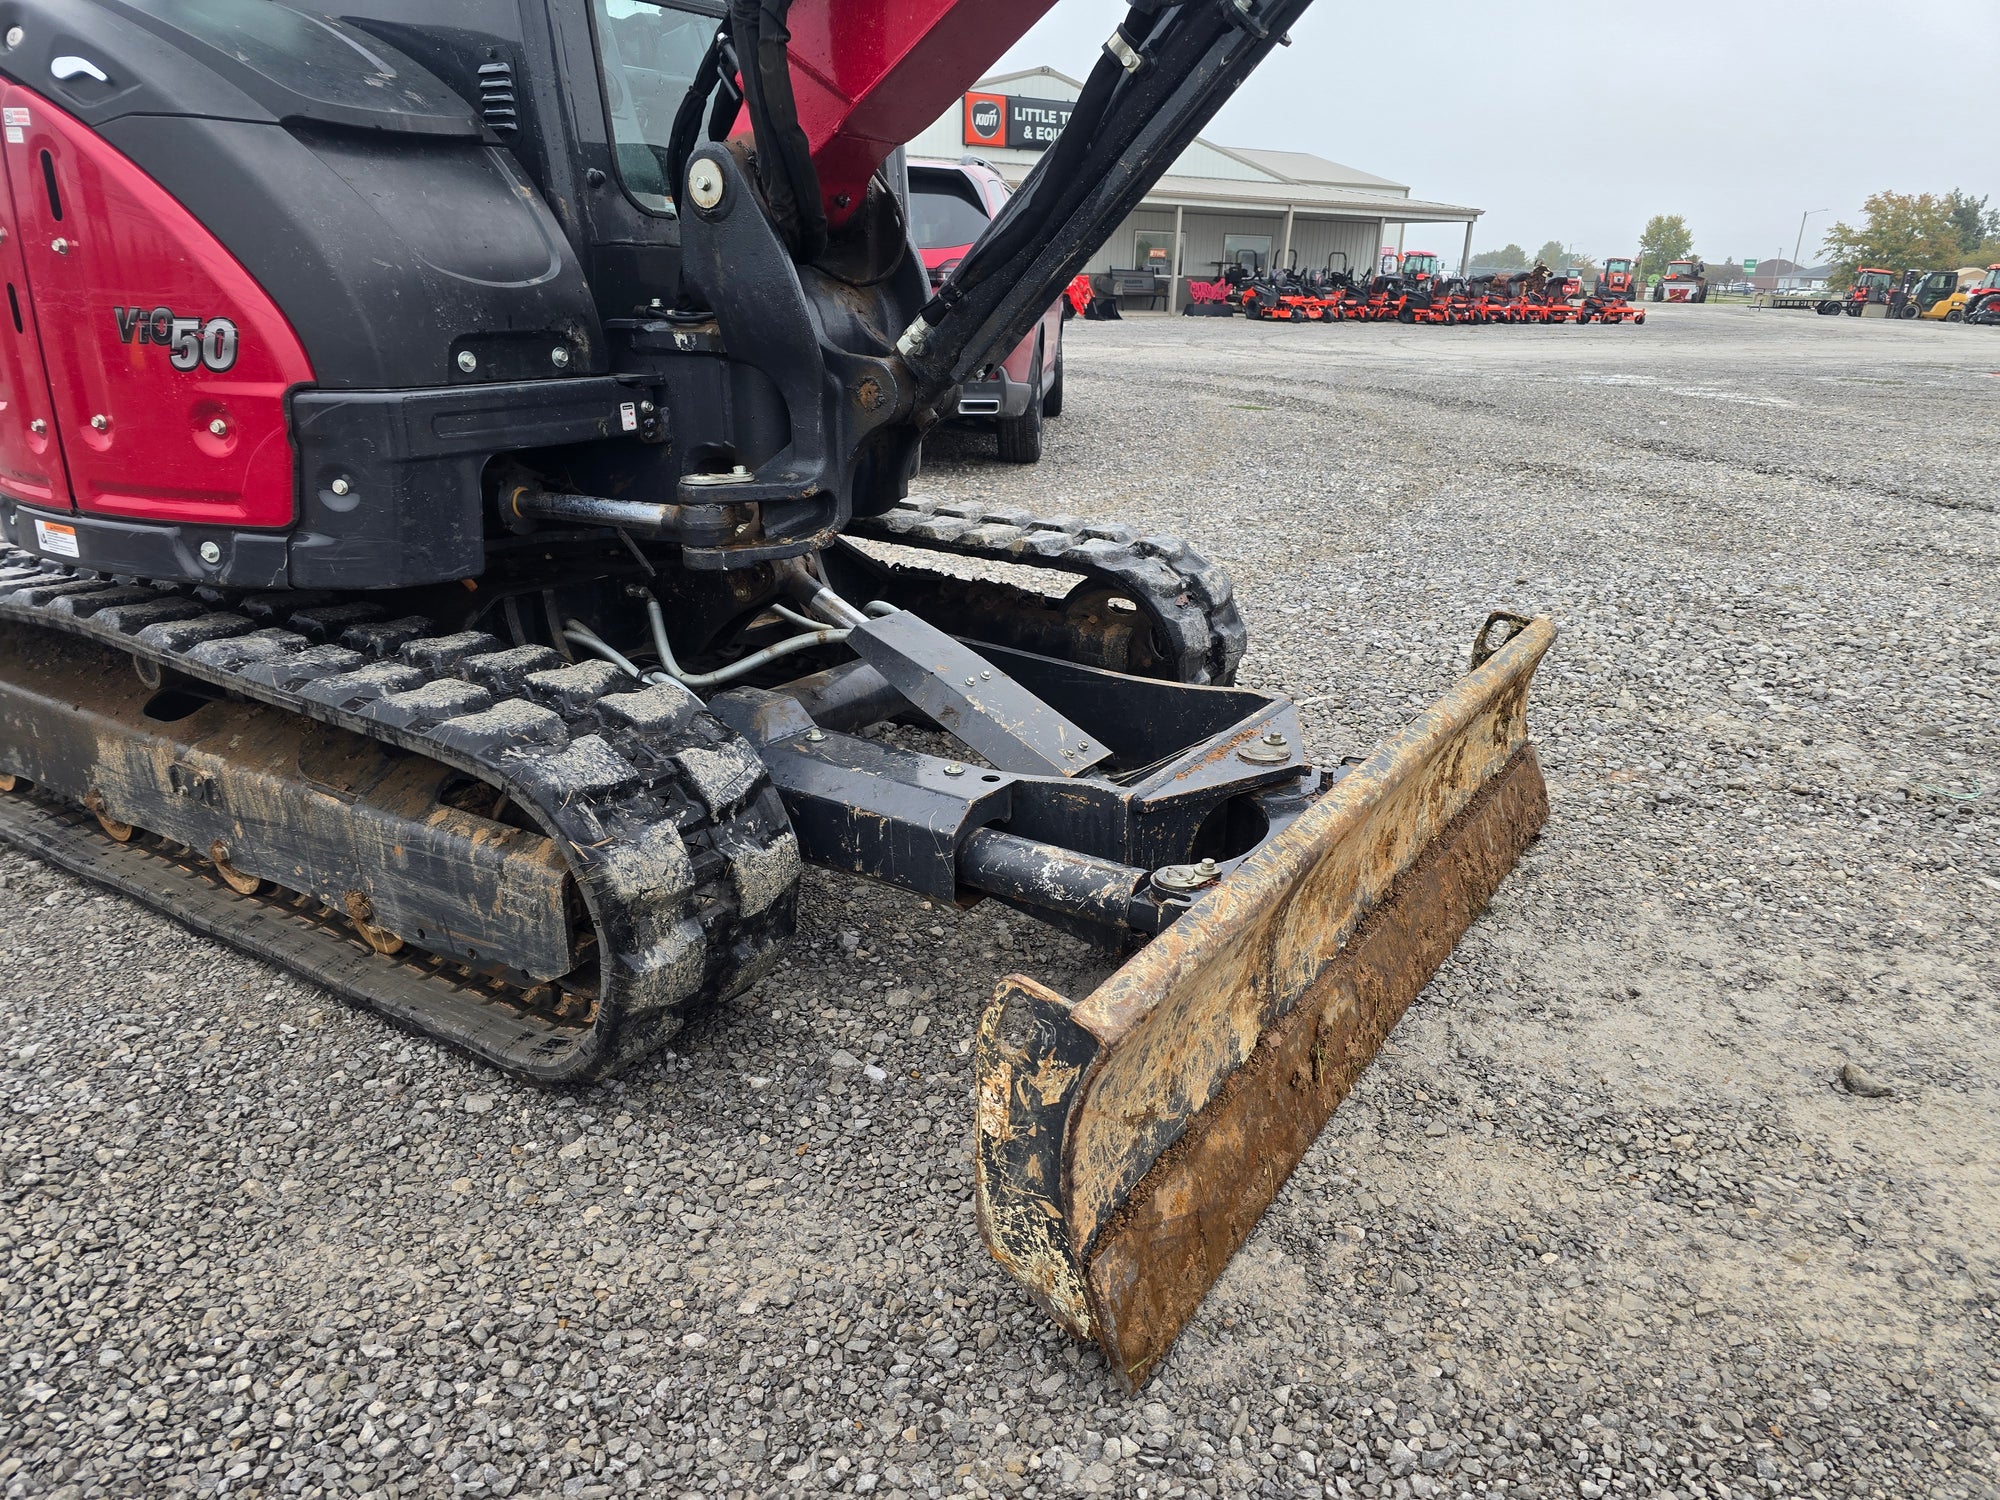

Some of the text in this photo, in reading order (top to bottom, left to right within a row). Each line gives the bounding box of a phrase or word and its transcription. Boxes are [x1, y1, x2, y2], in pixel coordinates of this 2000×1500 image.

[975, 108, 998, 127] KIOTI
[1014, 107, 1057, 123] LITTLE
[1023, 125, 1033, 140] &
